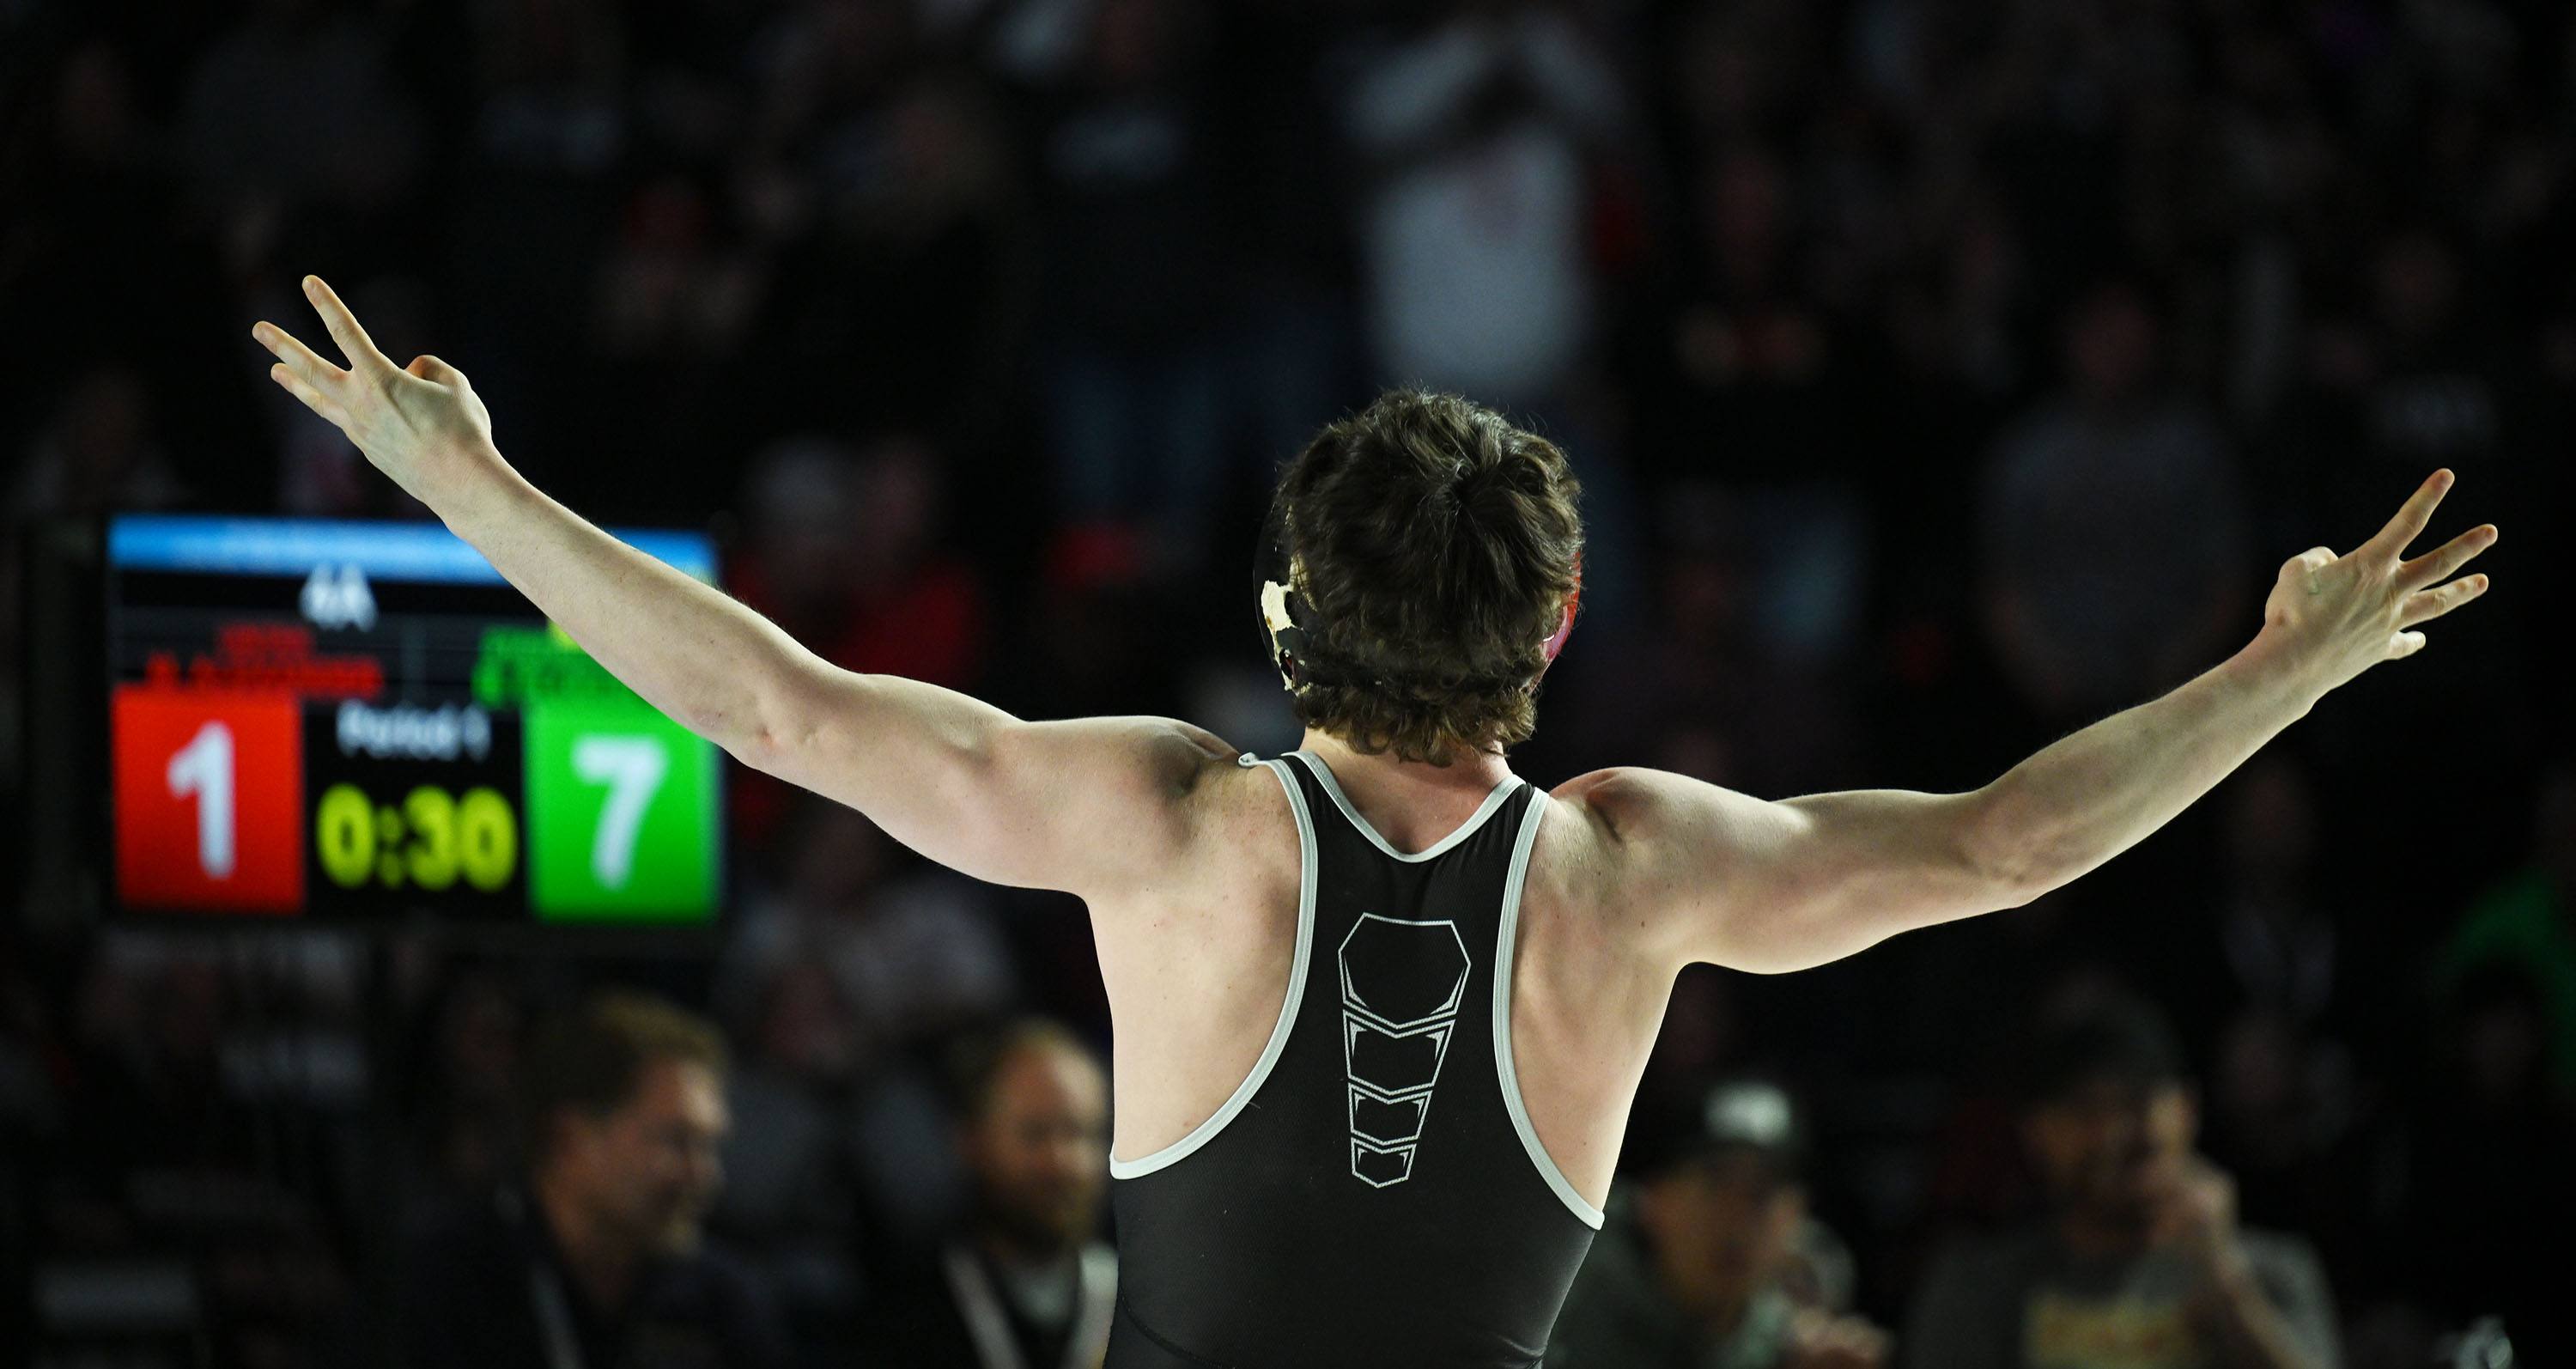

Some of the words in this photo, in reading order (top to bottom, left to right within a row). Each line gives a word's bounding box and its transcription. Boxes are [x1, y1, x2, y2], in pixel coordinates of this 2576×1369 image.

[337, 700, 462, 759] Period
[169, 722, 238, 878] 1
[317, 783, 515, 890] 0:30
[573, 735, 668, 890] 7
